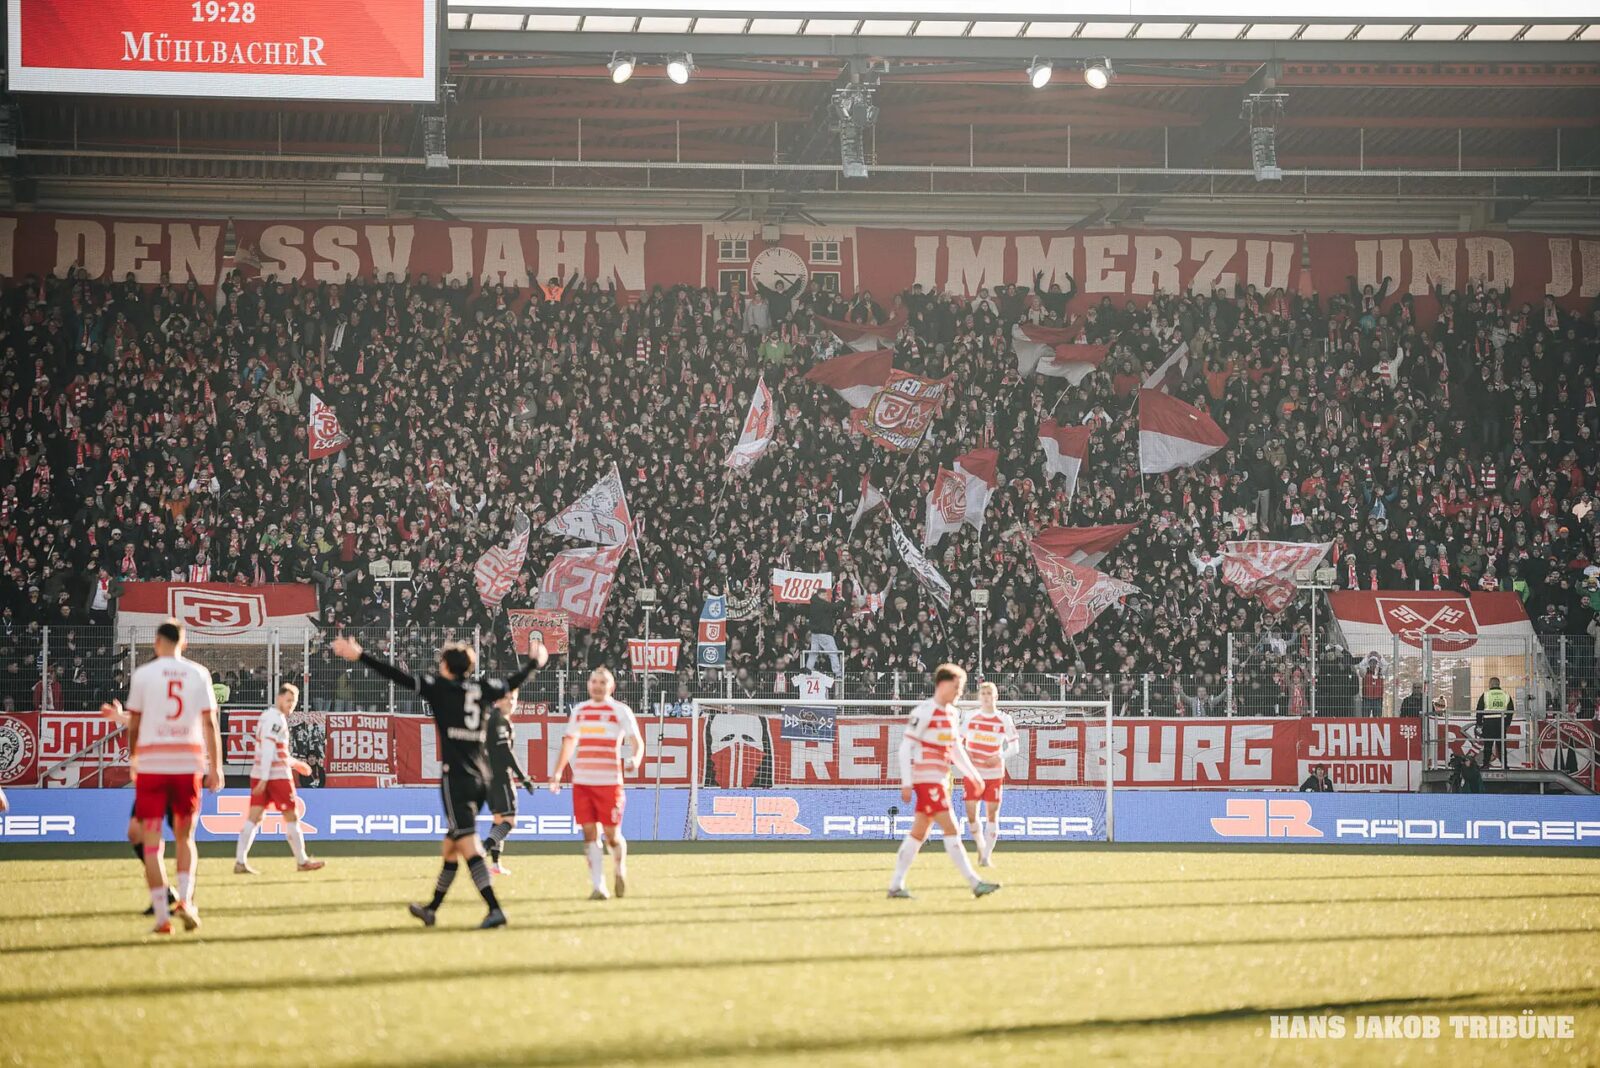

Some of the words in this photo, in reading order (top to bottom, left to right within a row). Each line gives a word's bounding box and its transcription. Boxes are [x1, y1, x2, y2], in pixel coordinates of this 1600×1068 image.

[191, 1, 256, 24] 19:28
[120, 31, 327, 66] MÜHLBACHER
[53, 218, 221, 285] DEN
[259, 224, 415, 285] SSV
[445, 226, 647, 291] JAHN
[914, 234, 1295, 299] IMMERZU
[1354, 236, 1515, 296] UND
[166, 679, 184, 721] 5
[806, 679, 820, 695] 24
[329, 716, 353, 729] SSV
[463, 682, 483, 731] 5
[43, 721, 129, 755] JAHN
[330, 730, 389, 761] 1889
[1308, 723, 1392, 757] JAHN
[329, 762, 390, 774] REGENSBURG
[0, 815, 76, 836] ER
